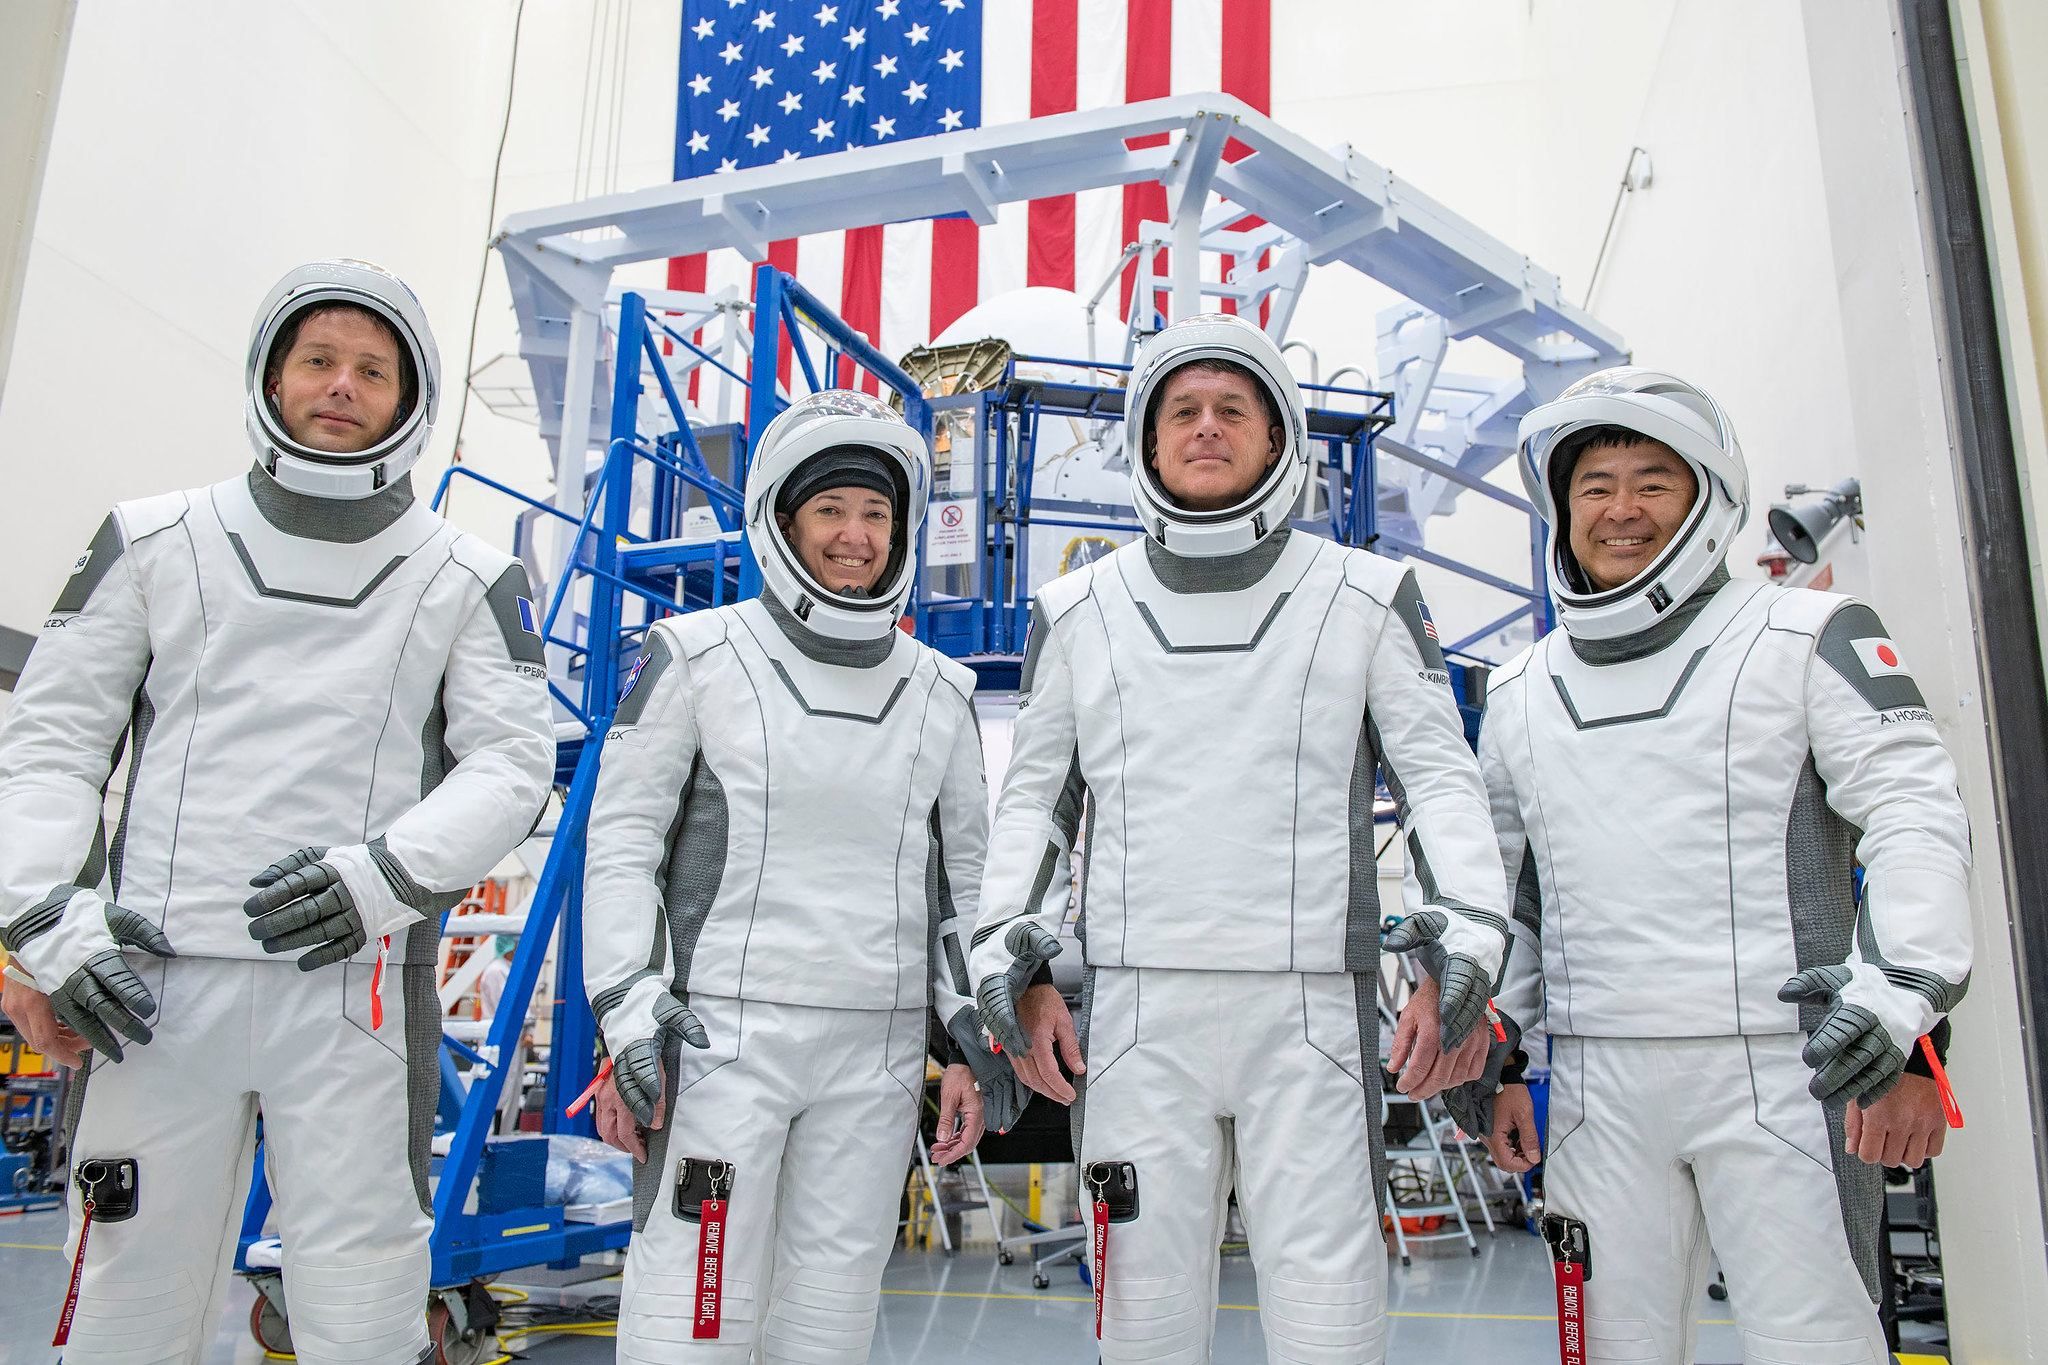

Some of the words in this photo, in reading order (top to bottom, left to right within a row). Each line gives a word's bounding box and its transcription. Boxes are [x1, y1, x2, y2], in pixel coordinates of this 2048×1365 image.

[705, 1221, 720, 1255] REMOVE
[1096, 1223, 1104, 1257] REMOVE
[71, 1262, 82, 1295] BEFORE
[703, 1257, 718, 1289] BEFORE
[63, 1298, 75, 1327] FLIGHT
[1563, 1285, 1578, 1319] REMOVE
[1565, 1320, 1579, 1354] BEFORE
